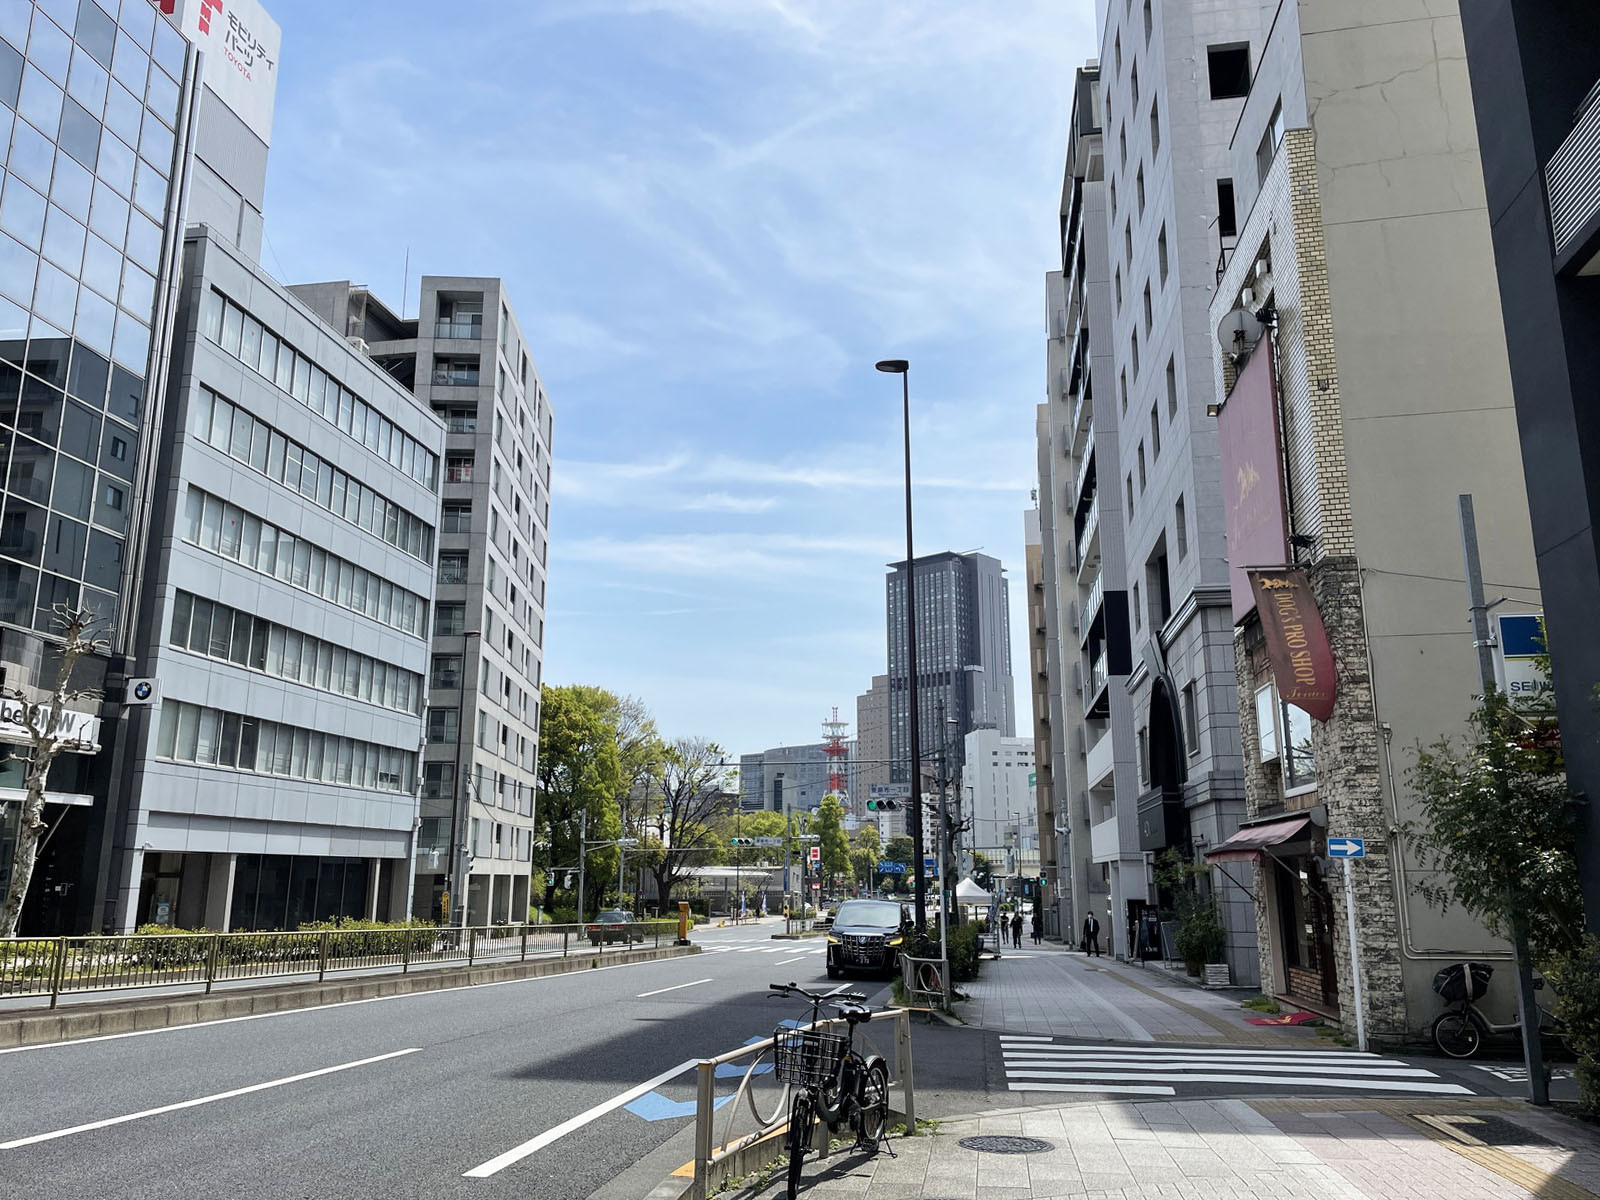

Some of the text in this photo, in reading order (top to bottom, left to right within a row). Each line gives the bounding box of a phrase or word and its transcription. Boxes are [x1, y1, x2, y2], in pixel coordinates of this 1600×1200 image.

[226, 30, 254, 67] パーツ
[227, 10, 274, 70] モビリティ
[224, 47, 251, 81] TOYOTA
[1284, 624, 1308, 649] PRO
[1290, 650, 1316, 686] SHOP
